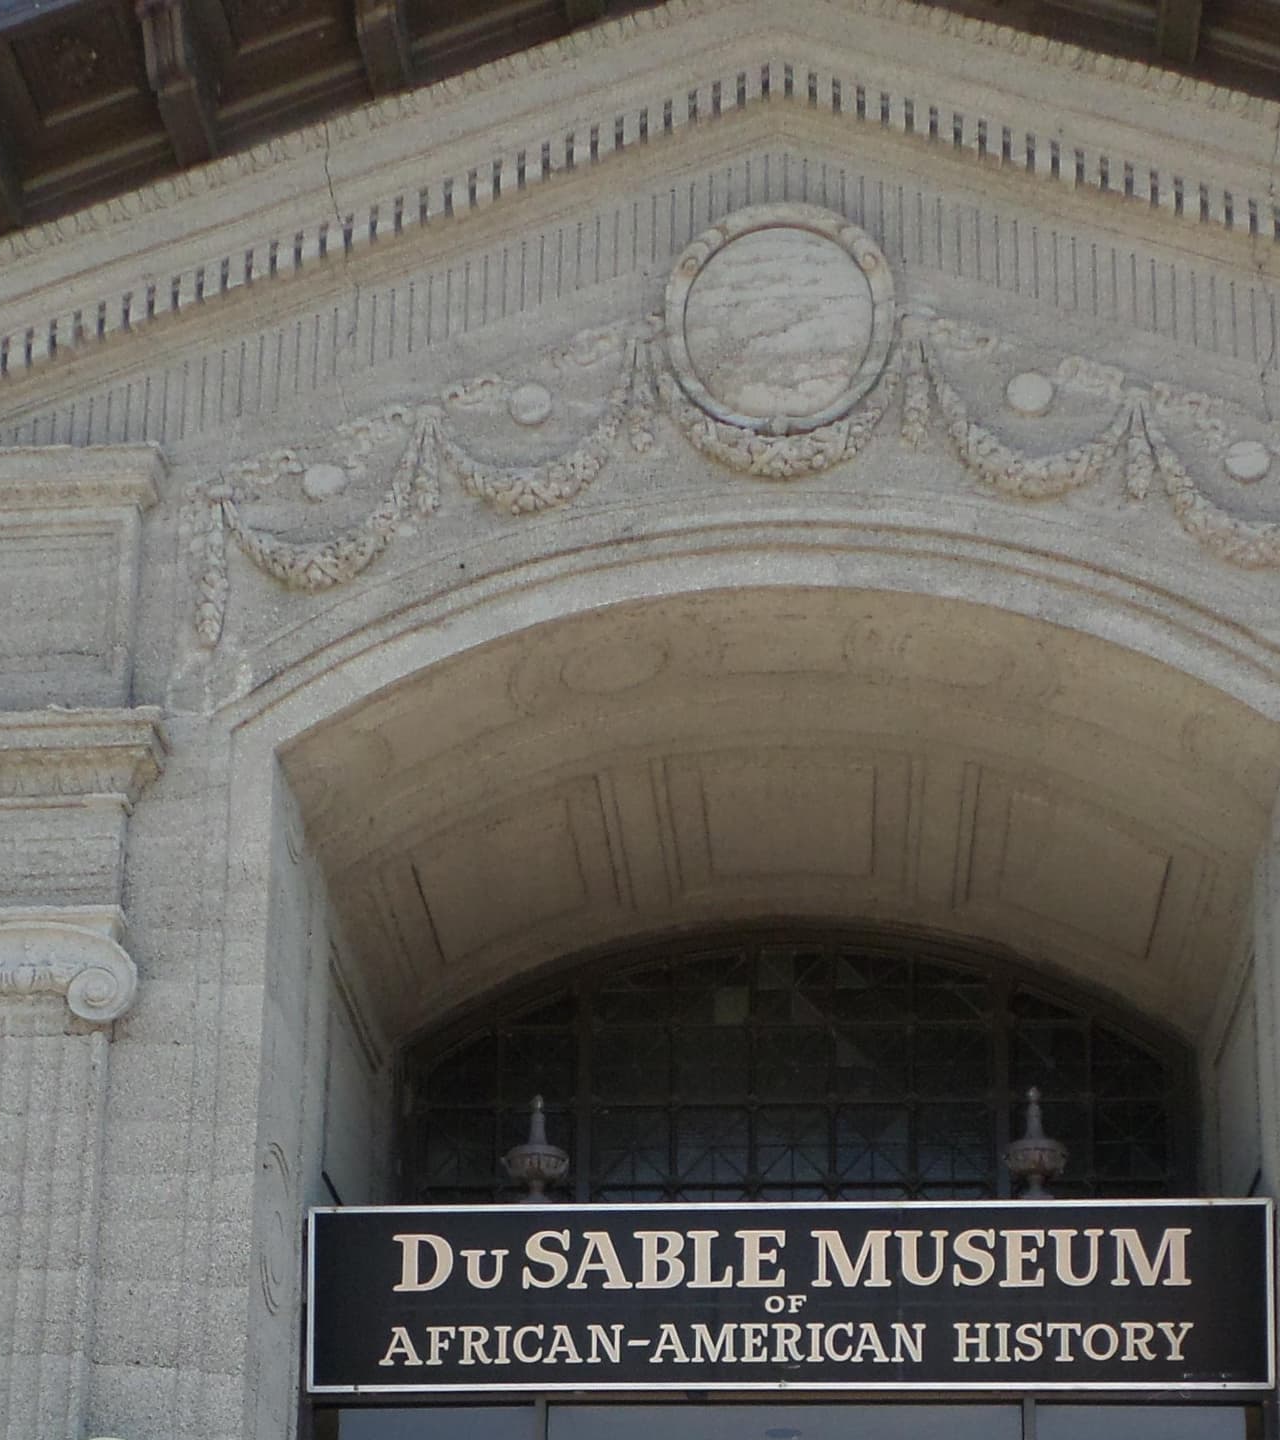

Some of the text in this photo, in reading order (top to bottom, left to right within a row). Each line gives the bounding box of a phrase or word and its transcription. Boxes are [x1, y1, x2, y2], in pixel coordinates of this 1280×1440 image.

[810, 1228, 1192, 1288] MUSEUM
[764, 1294, 807, 1314] OF
[378, 1321, 1194, 1366] AFRICAN-AMERICAN HISTORY
